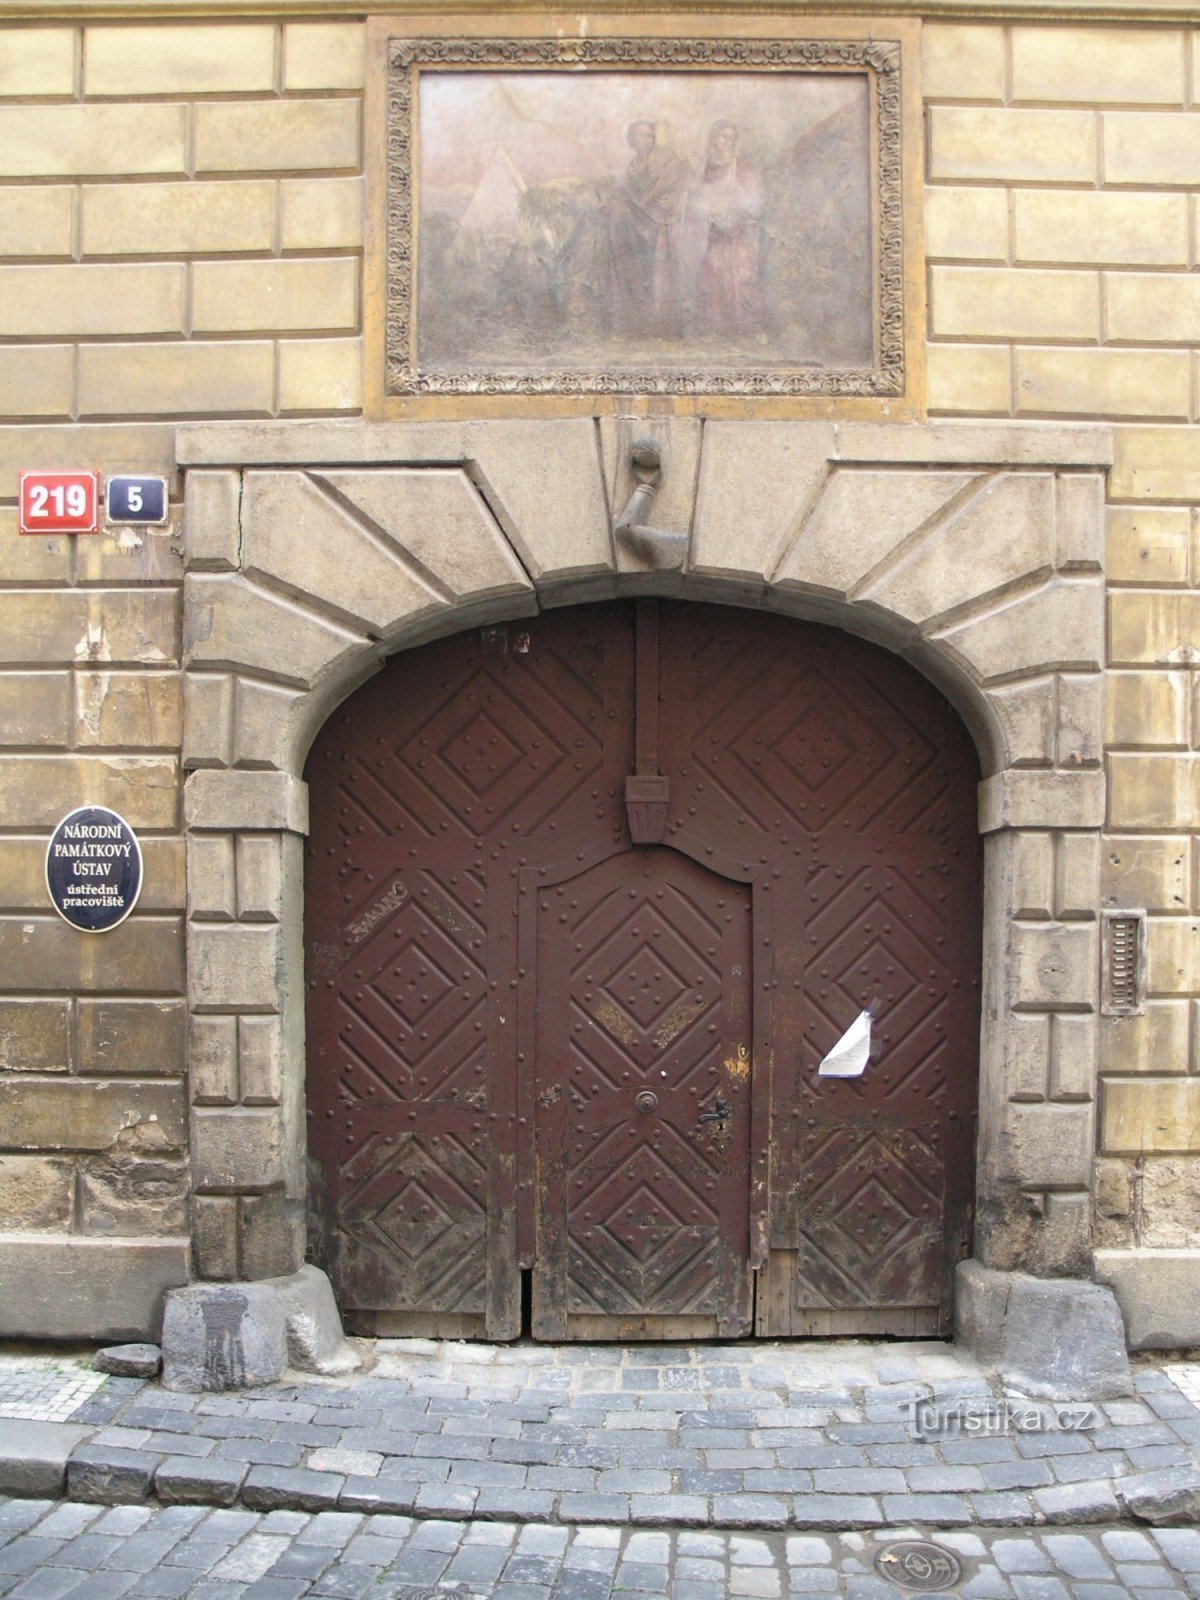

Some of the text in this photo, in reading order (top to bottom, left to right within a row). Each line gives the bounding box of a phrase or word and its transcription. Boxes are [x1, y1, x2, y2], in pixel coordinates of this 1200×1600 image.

[29, 484, 87, 518] 219
[127, 486, 143, 512] 5
[64, 823, 122, 838] NÁRODNÍ
[54, 842, 131, 857] PAMÁTKOVÝ
[73, 860, 112, 876] ÚSTAV
[67, 884, 119, 895] ústřední
[63, 896, 124, 909] pracoviště
